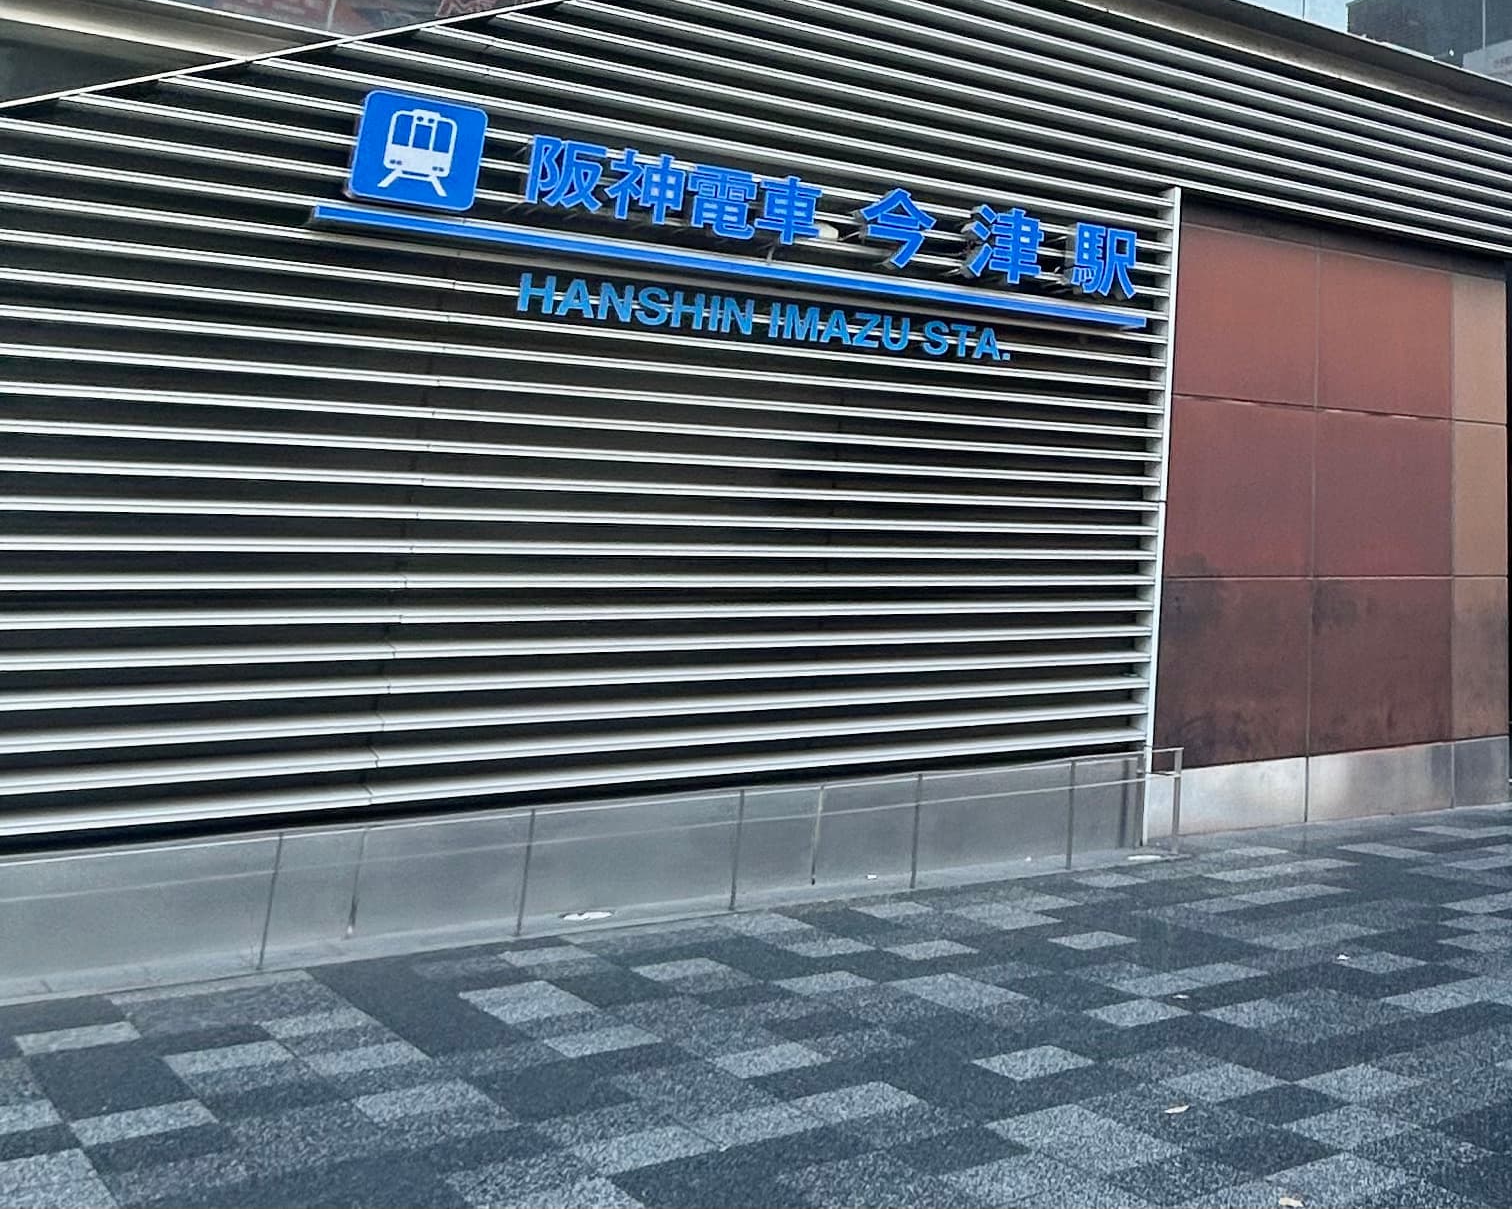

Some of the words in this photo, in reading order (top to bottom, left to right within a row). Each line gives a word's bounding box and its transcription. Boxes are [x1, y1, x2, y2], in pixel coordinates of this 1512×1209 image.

[524, 134, 823, 245] 阪神電車
[858, 188, 1138, 298] 今津駅
[517, 272, 755, 335] HANSHIN
[767, 302, 911, 352] IMAZU
[922, 321, 1012, 361] STA.
